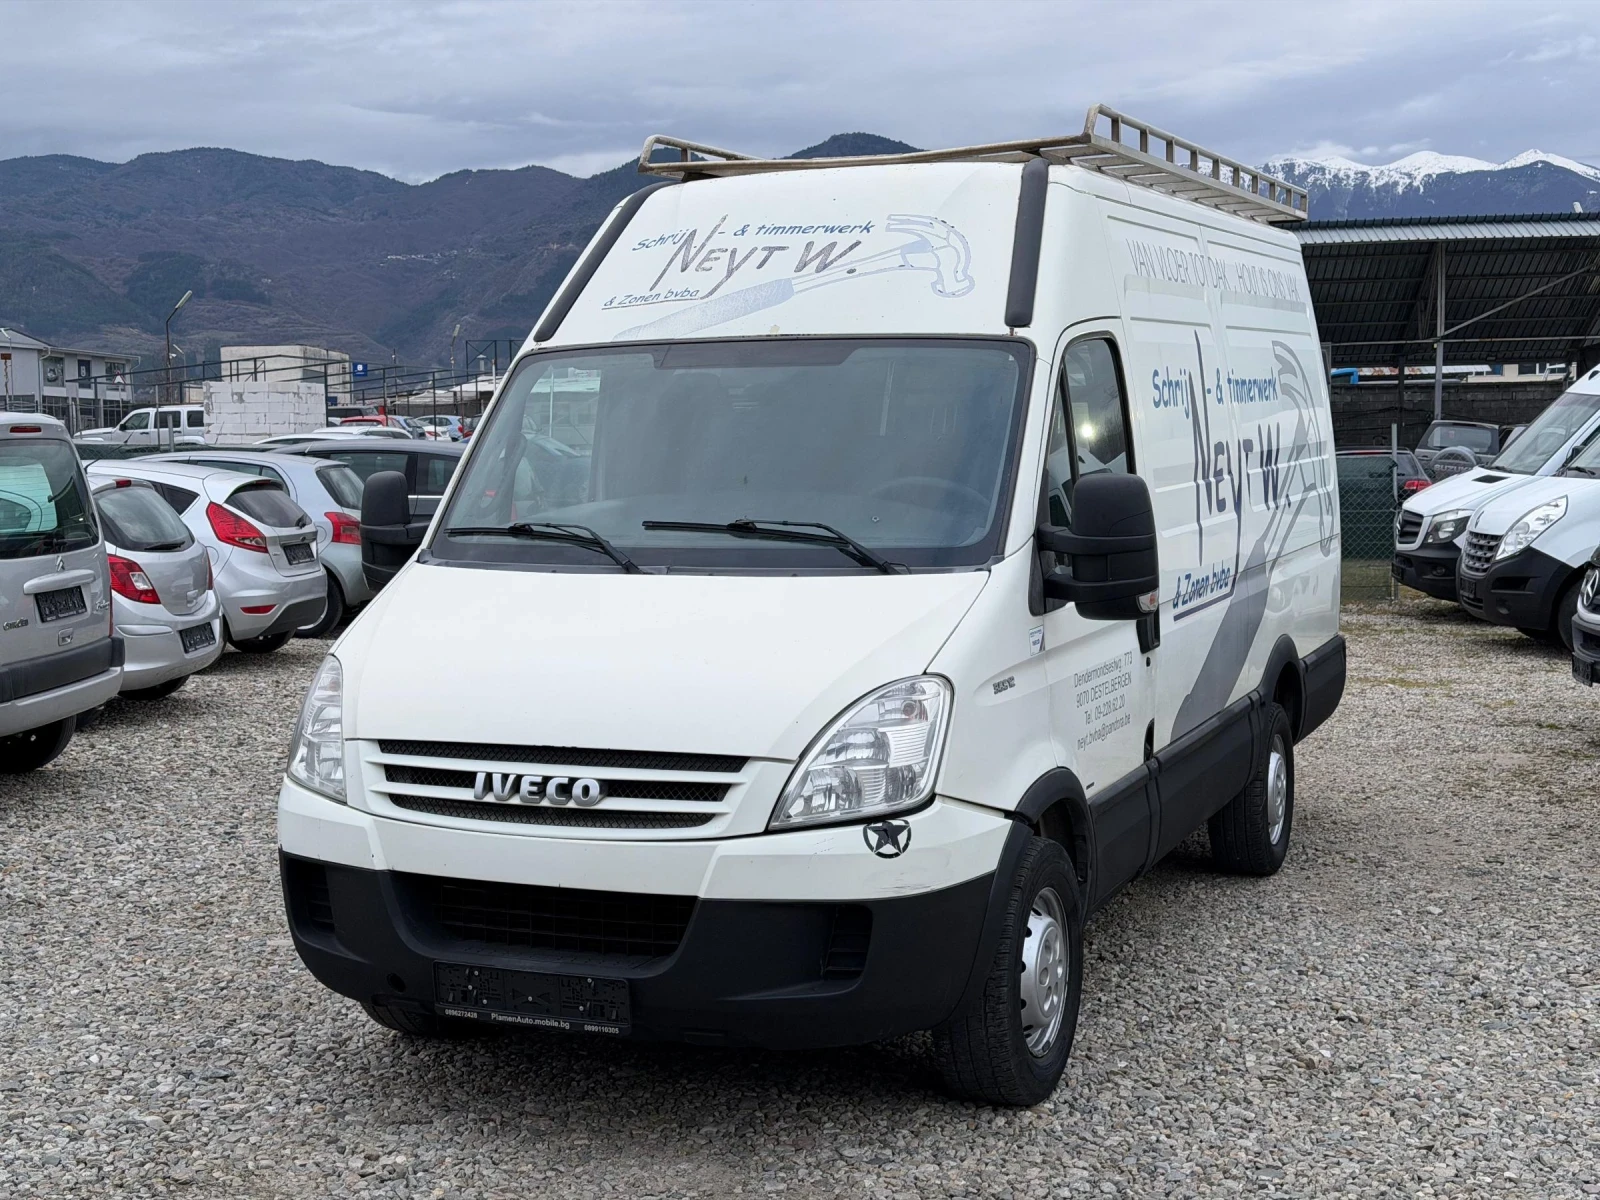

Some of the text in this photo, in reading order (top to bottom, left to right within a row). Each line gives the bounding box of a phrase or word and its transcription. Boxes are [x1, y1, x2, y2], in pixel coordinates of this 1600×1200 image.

[733, 224, 750, 237] &
[755, 220, 875, 236] timmerwerk
[794, 240, 862, 274] W.
[1126, 239, 1157, 278] VAN
[1153, 244, 1192, 284] VLOER
[1188, 252, 1209, 288] TOT
[603, 287, 700, 307] & Zonen bvba
[1216, 368, 1224, 405] &
[1227, 367, 1278, 405] timmerwerk
[1258, 422, 1292, 511] W.
[1434, 464, 1472, 472] SUZUK
[1173, 560, 1231, 609] & Zonen bvba
[1091, 671, 1132, 702] DESTELBERGEN
[474, 771, 606, 807] IVECO
[491, 1012, 570, 1030] PlamenAuto.mobile.bg
